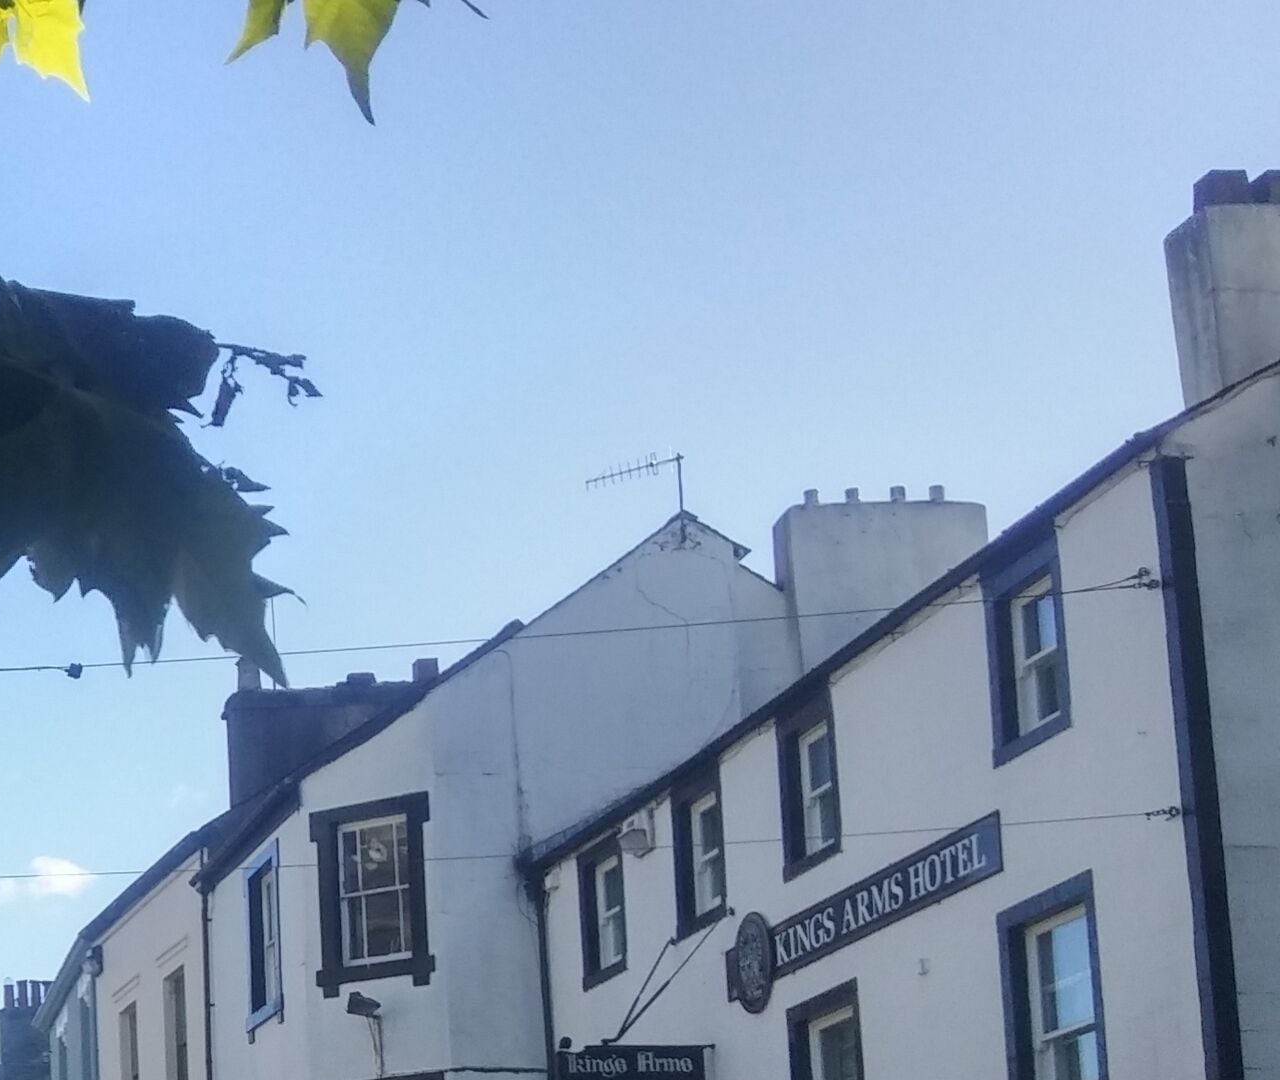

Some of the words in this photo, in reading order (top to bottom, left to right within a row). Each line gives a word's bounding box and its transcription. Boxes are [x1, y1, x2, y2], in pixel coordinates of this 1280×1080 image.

[773, 906, 836, 967] KINGS
[841, 871, 904, 935] ARMS
[907, 832, 988, 901] HOTEL
[637, 1051, 694, 1073] Arms
